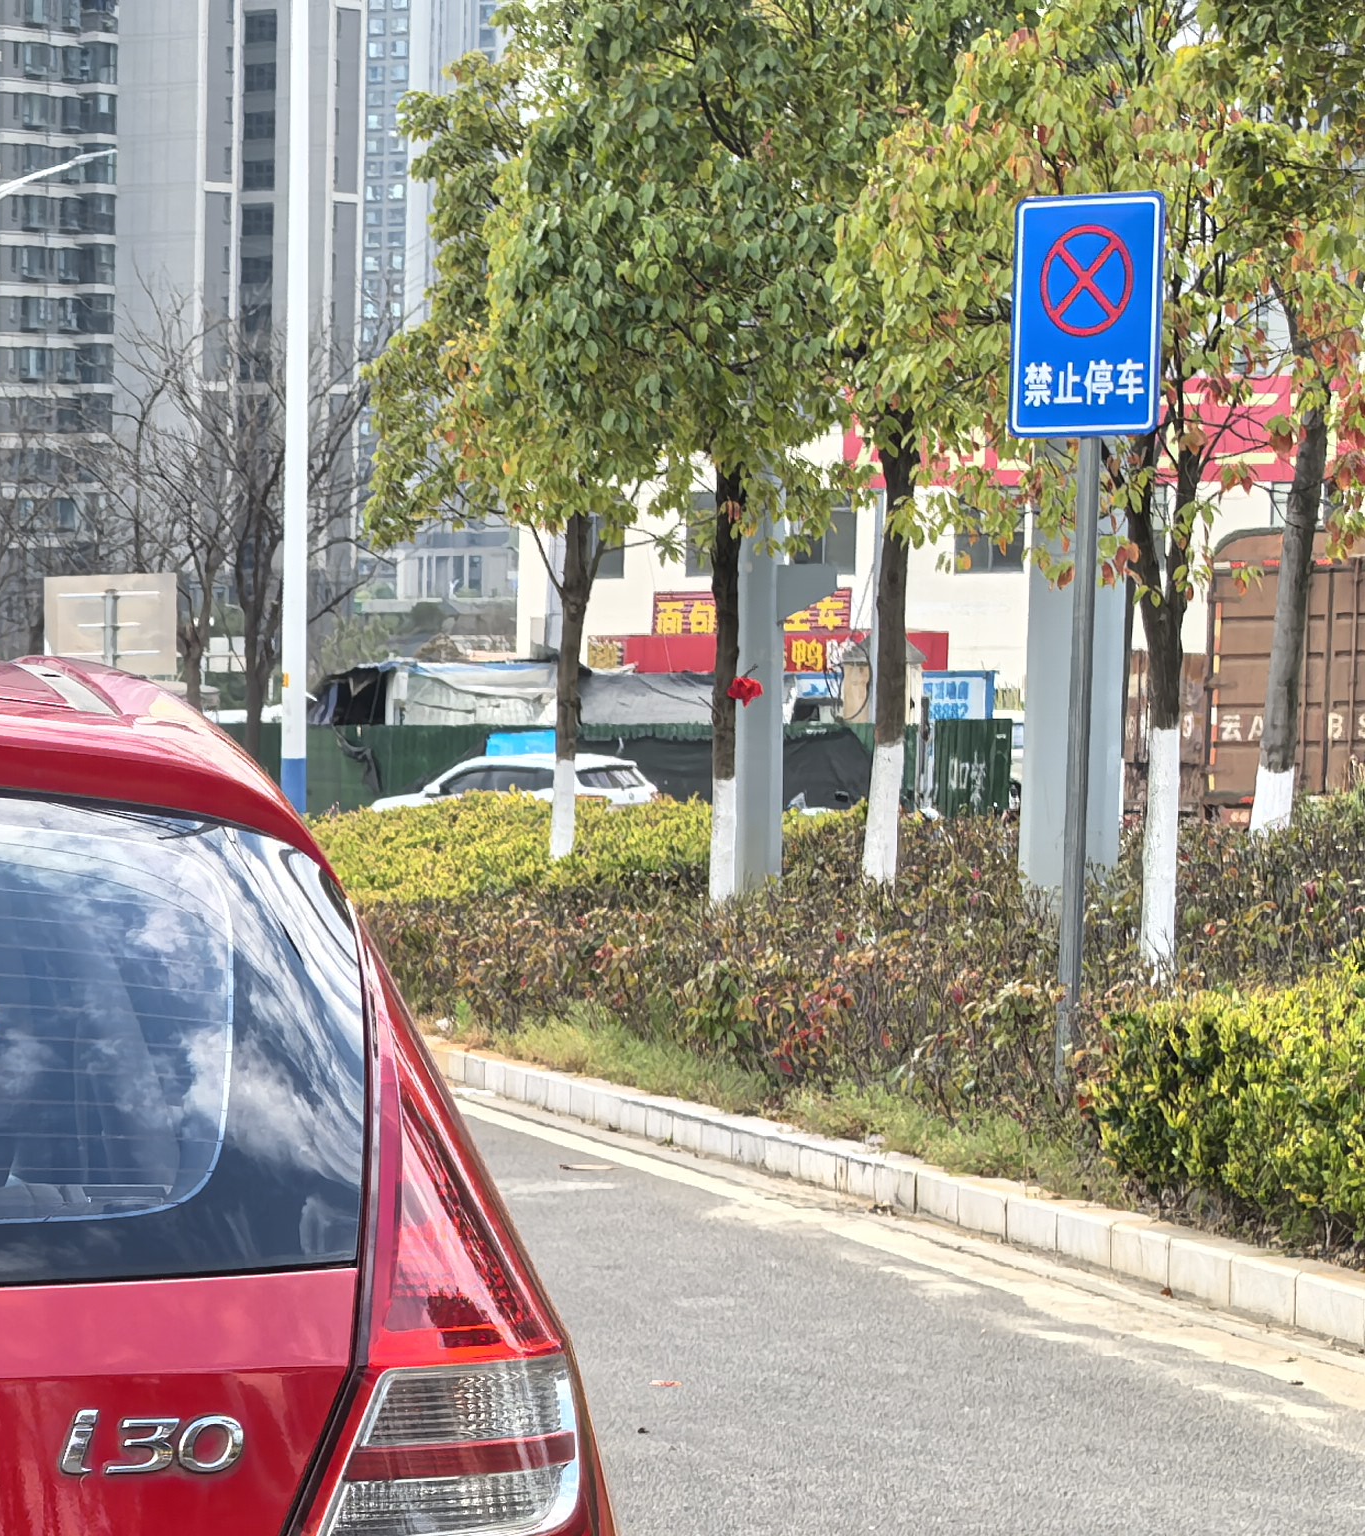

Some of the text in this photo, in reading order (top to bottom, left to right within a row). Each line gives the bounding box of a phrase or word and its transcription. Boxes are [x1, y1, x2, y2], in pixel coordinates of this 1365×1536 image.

[1024, 359, 1145, 407] 禁止停车
[59, 1409, 245, 1475] i30
